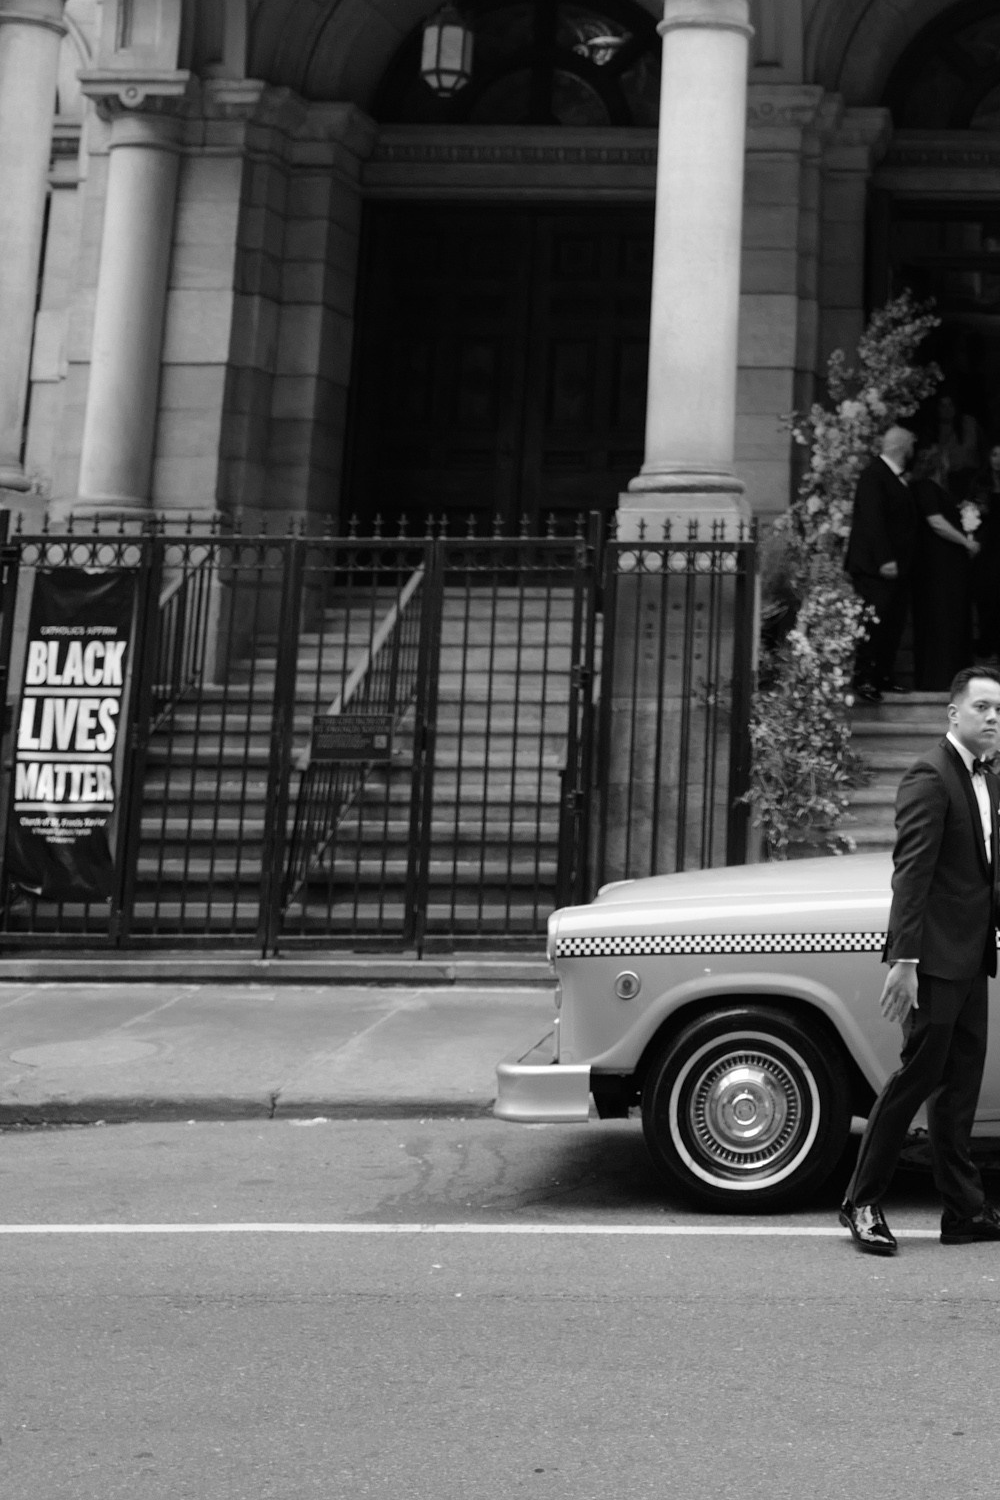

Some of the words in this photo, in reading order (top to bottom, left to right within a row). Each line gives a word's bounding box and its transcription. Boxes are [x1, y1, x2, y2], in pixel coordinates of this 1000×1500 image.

[25, 640, 127, 687] BLACK
[17, 697, 120, 752] LIVES
[15, 762, 115, 802] MATTER
